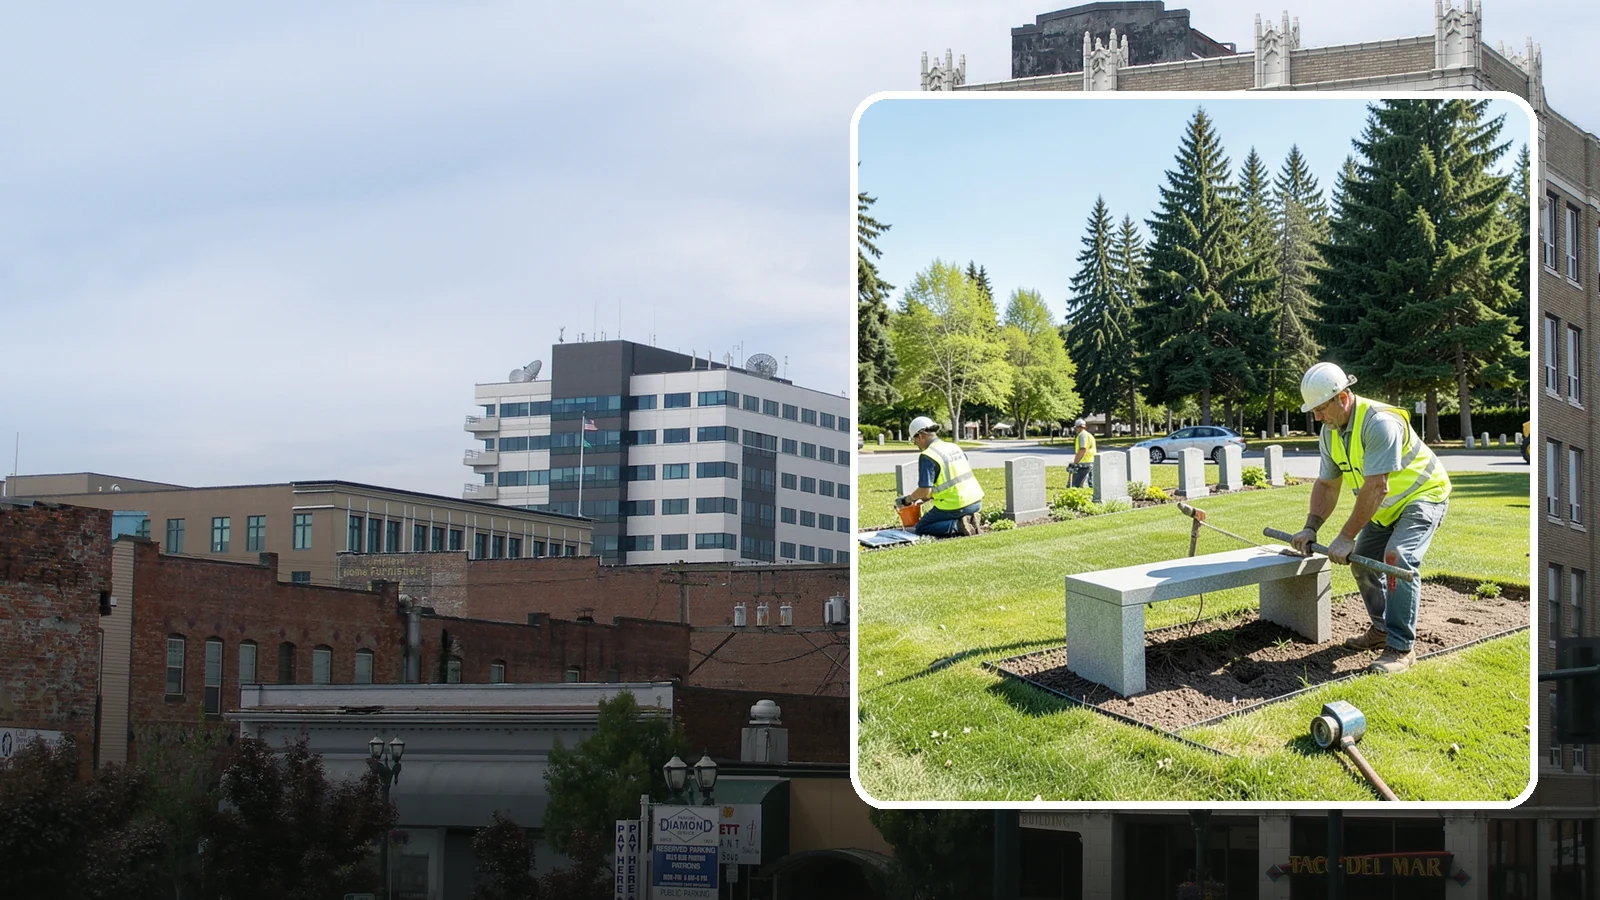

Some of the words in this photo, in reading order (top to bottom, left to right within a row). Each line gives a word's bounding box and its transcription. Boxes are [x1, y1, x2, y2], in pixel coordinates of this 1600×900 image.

[343, 568, 368, 577] Home
[370, 566, 427, 577] Furnishers
[660, 818, 713, 832] DIAMOND
[1022, 815, 1070, 828] BUILDING
[617, 825, 625, 852] PAY
[628, 824, 637, 852] PAY
[656, 845, 688, 853] RESERVED
[689, 846, 716, 854] PARKING
[671, 862, 701, 870] PATRONS
[1345, 856, 1385, 875] DEL
[1392, 857, 1442, 876] MAR
[616, 856, 625, 893] HERE
[627, 856, 636, 893] HERE
[660, 889, 682, 897] PUBLIC
[684, 889, 710, 898] PARKING
